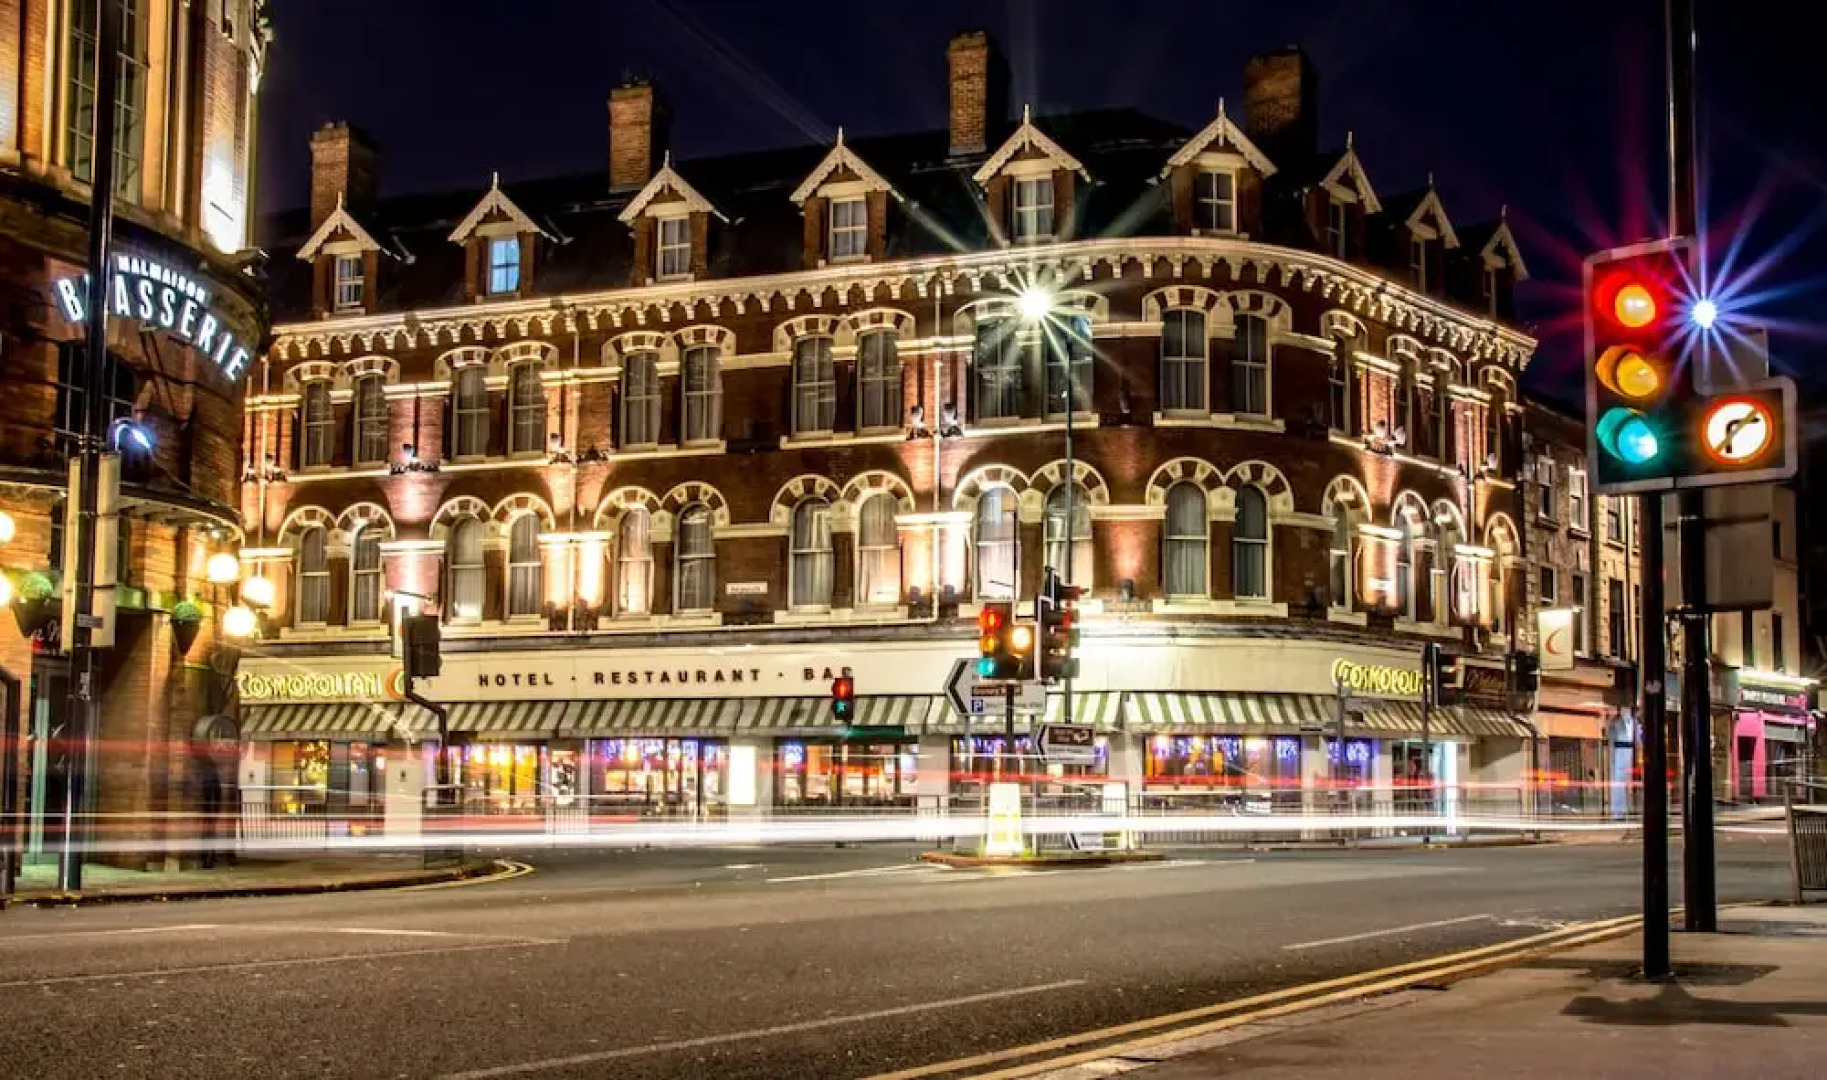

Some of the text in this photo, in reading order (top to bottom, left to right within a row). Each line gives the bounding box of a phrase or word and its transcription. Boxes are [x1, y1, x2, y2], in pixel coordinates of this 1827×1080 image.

[57, 273, 249, 382] BASSERIE
[234, 670, 383, 698] COSMOPOLITAN
[478, 673, 554, 688] HOTEL
[593, 668, 761, 685] RESTAURANT
